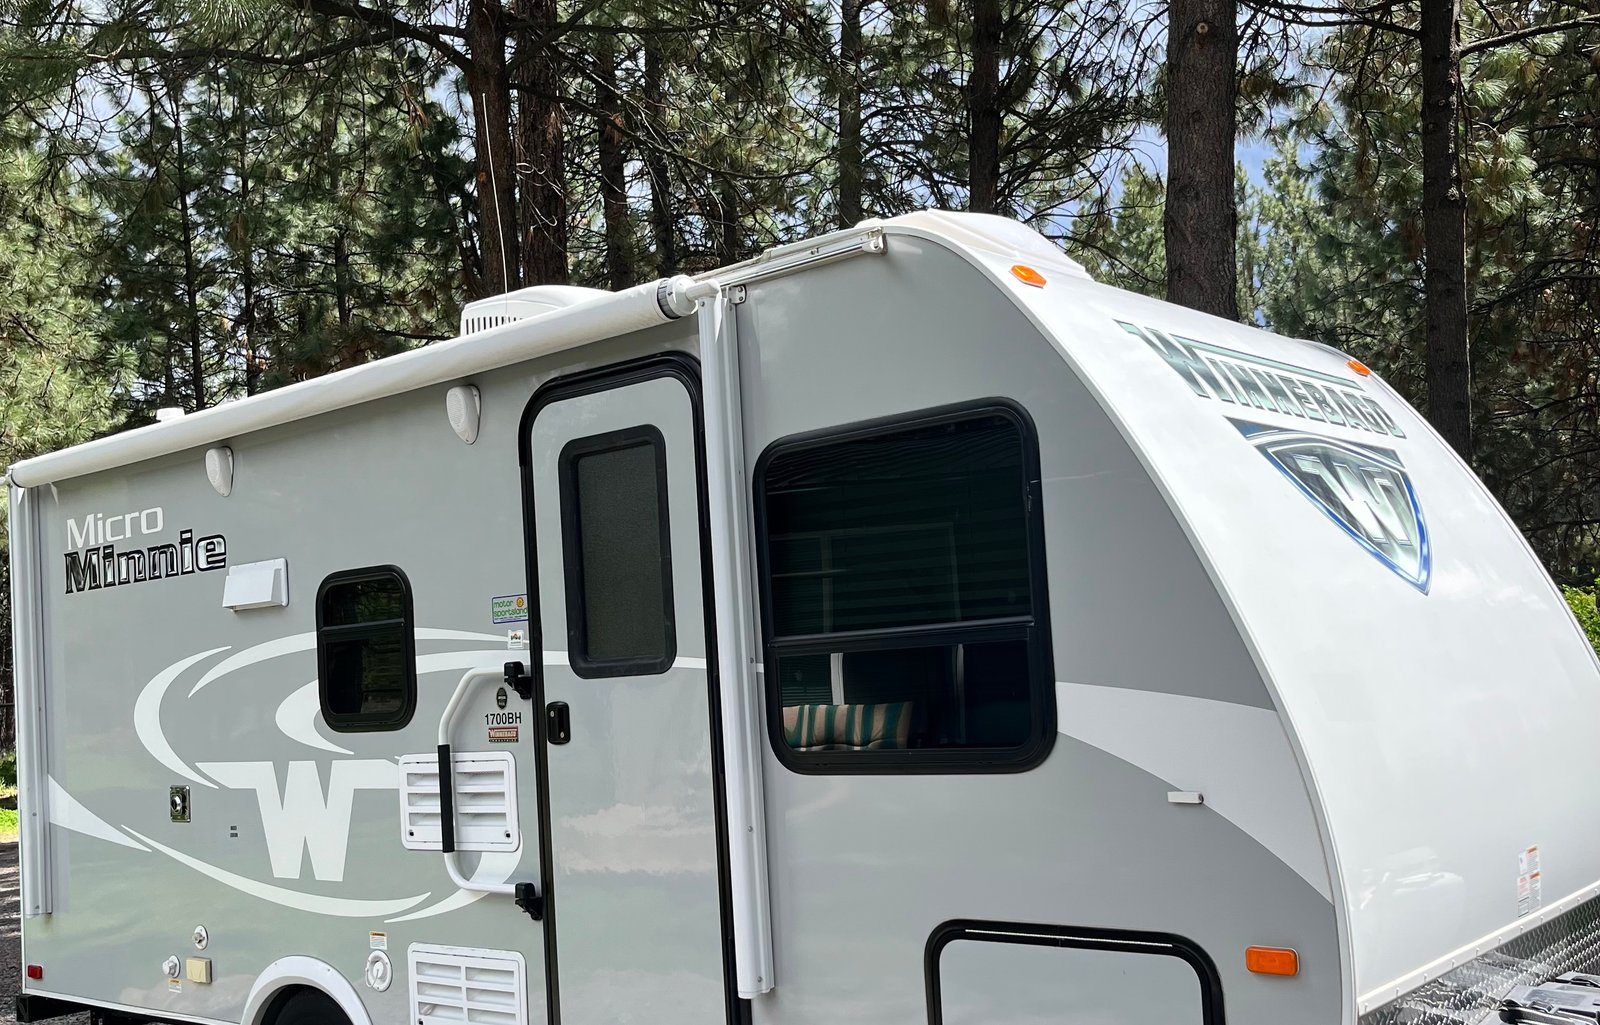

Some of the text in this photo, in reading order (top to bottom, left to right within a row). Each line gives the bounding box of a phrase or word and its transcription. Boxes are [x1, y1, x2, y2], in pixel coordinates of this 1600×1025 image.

[1113, 319, 1406, 439] WINNEBAGO
[67, 506, 164, 550] Micro
[64, 529, 227, 595] Minnie
[493, 600, 513, 609] motor
[494, 607, 528, 618] sportsland
[484, 711, 522, 725] 1700BH
